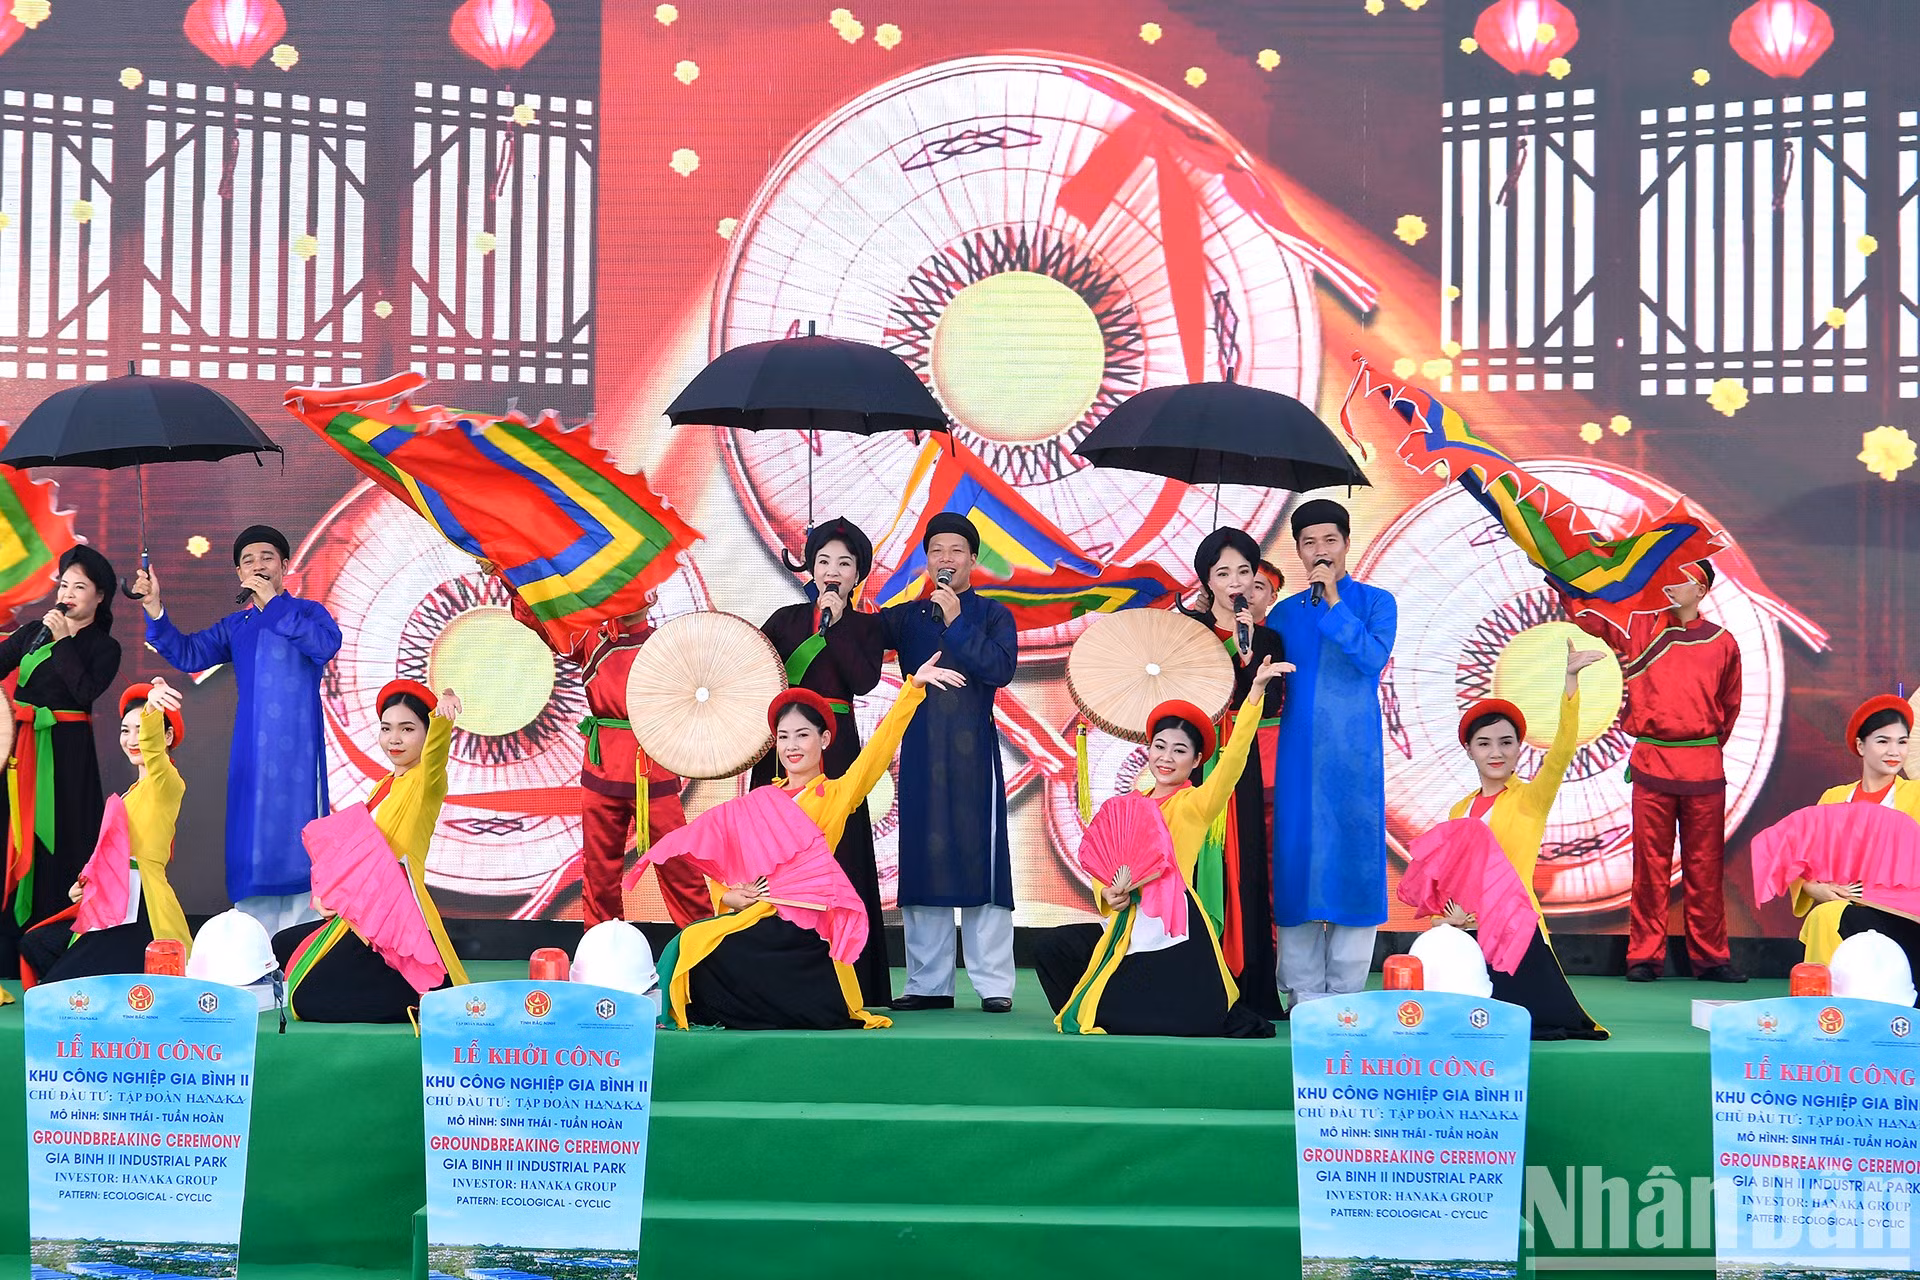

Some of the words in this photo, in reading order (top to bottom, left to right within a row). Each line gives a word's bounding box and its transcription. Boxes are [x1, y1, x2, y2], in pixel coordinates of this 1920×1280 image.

[56, 1033, 84, 1058] LỄ
[91, 1036, 151, 1060] KHỞI
[157, 1038, 223, 1062] CÔNG
[452, 1039, 481, 1064] LỄ
[488, 1042, 549, 1066] KHỞI
[555, 1044, 621, 1068] CÔNG
[1324, 1050, 1353, 1075] LỄ
[1360, 1053, 1422, 1077] KHỞI
[1429, 1054, 1496, 1078] CÔNG
[1743, 1055, 1772, 1080] LỄ
[1779, 1059, 1842, 1083] KHỞI
[1848, 1062, 1916, 1086] CÔNG
[29, 1070, 58, 1082] KHU
[63, 1068, 108, 1084] CÔNG
[112, 1069, 166, 1088] NGHIỆP
[170, 1073, 197, 1085] GIA
[202, 1070, 236, 1086] BÌNH
[240, 1075, 249, 1086] II
[426, 1076, 455, 1088] KHU
[460, 1074, 506, 1090] CÔNG
[510, 1075, 564, 1094] NGHIỆP
[568, 1079, 595, 1091] GIA
[600, 1077, 634, 1092] BÌNH
[639, 1081, 647, 1093] II
[29, 1089, 58, 1101] CHỦ
[118, 1092, 142, 1105] TẬP
[145, 1091, 181, 1103] ĐOÀN
[186, 1095, 247, 1105] HANAKA
[426, 1095, 455, 1107] CHỦ
[516, 1098, 540, 1111] TẬP
[543, 1097, 580, 1109] ĐOÀN
[584, 1101, 645, 1111] HANAKA
[1297, 1087, 1327, 1100] KHU
[1332, 1085, 1379, 1101] CÔNG
[1383, 1086, 1439, 1105] NGHIỆP
[1443, 1089, 1470, 1102] GIA
[1475, 1087, 1509, 1102] BÌNH
[1514, 1091, 1523, 1102] II
[1715, 1091, 1746, 1104] KHU
[1750, 1090, 1798, 1106] CÔNG
[1802, 1092, 1858, 1112] NGHIỆP
[1862, 1097, 1889, 1110] GIA
[1894, 1096, 1920, 1111] BÌN
[50, 1108, 68, 1120] MÔ
[71, 1109, 100, 1121] HÌNH:
[102, 1112, 126, 1122] SINH
[130, 1110, 153, 1122] THÁI
[192, 1112, 224, 1124] HOÀN
[447, 1114, 465, 1125] MÔ
[468, 1115, 497, 1127] HÌNH:
[500, 1118, 524, 1128] SINH
[528, 1116, 551, 1128] THÁI
[591, 1118, 623, 1130] HOÀN
[1297, 1106, 1327, 1118] CHỦ
[1389, 1109, 1415, 1122] TẬP
[1417, 1108, 1454, 1120] ĐOÀN
[1459, 1111, 1521, 1121] HANAKA
[1715, 1111, 1745, 1123] CHỦ
[1808, 1115, 1833, 1129] TẬP
[1836, 1116, 1873, 1128] ĐOÀN
[1878, 1120, 1920, 1130] HANA
[33, 1130, 162, 1147] GROUNDBREAKING
[166, 1133, 241, 1148] CEREMONY
[1320, 1126, 1338, 1137] MÔ
[1341, 1126, 1371, 1138] HÌNH:
[1374, 1129, 1398, 1139] SINH
[1402, 1127, 1426, 1139] THÁI
[1466, 1128, 1498, 1140] HOÀN
[1737, 1131, 1756, 1142] MÔ
[1759, 1132, 1789, 1144] HÌNH:
[1792, 1135, 1816, 1145] SINH
[1820, 1134, 1844, 1146] THÁI
[1885, 1137, 1917, 1149] HOÀN
[430, 1136, 560, 1153] GROUNDBREAKING
[564, 1139, 640, 1155] CEREMONY
[45, 1153, 70, 1164] GIA
[74, 1153, 104, 1165] BINH
[108, 1154, 115, 1165] II
[119, 1155, 191, 1167] INDUSTRIAL
[194, 1157, 228, 1167] PARK
[1302, 1147, 1435, 1164] GROUNDBREAKING
[1439, 1150, 1516, 1165] CEREMONY
[1719, 1153, 1853, 1171] GROUNDBREAKING
[1857, 1159, 1920, 1175] CEREMO
[443, 1159, 468, 1170] GIA
[472, 1159, 502, 1171] BINH
[506, 1160, 513, 1171] II
[518, 1161, 589, 1173] INDUSTRIAL
[593, 1163, 626, 1174] PARK
[55, 1172, 119, 1184] INVESTOR:
[122, 1174, 173, 1185] HANAKA
[176, 1175, 218, 1185] GROUP
[452, 1178, 517, 1190] INVESTOR:
[521, 1180, 571, 1191] HANAKA
[575, 1181, 617, 1191] GROUP
[1316, 1171, 1341, 1182] GIA
[1346, 1171, 1376, 1183] BINH
[1381, 1172, 1388, 1183] II
[1392, 1172, 1465, 1184] INDUSTRIAL
[1469, 1173, 1503, 1184] PARK
[1732, 1176, 1758, 1187] GIA
[1762, 1177, 1793, 1188] BINH
[1797, 1178, 1805, 1189] II
[1809, 1180, 1883, 1192] INDUSTRIAL
[58, 1190, 100, 1200] PATTERN:
[103, 1192, 167, 1201] ECOLOGICAL
[176, 1192, 212, 1202] CYCLIC
[456, 1196, 498, 1206] PATTERN:
[501, 1198, 565, 1207] ECOLOGICAL
[575, 1199, 611, 1208] CYCLIC
[1326, 1190, 1392, 1202] INVESTOR:
[1396, 1191, 1447, 1202] HANAKA
[1451, 1192, 1493, 1202] GROUP
[1742, 1196, 1809, 1208] INVESTOR:
[1812, 1199, 1865, 1210] HANAKA
[1868, 1201, 1911, 1211] GROUP
[1330, 1209, 1373, 1218] PATTERN:
[1376, 1209, 1442, 1219] ECOLOGICAL
[1451, 1209, 1488, 1219] CYCLIC
[1746, 1214, 1789, 1224] PATTERN:
[1792, 1217, 1858, 1226] ECOLOGICAL
[1868, 1218, 1905, 1228] CYCLIC
